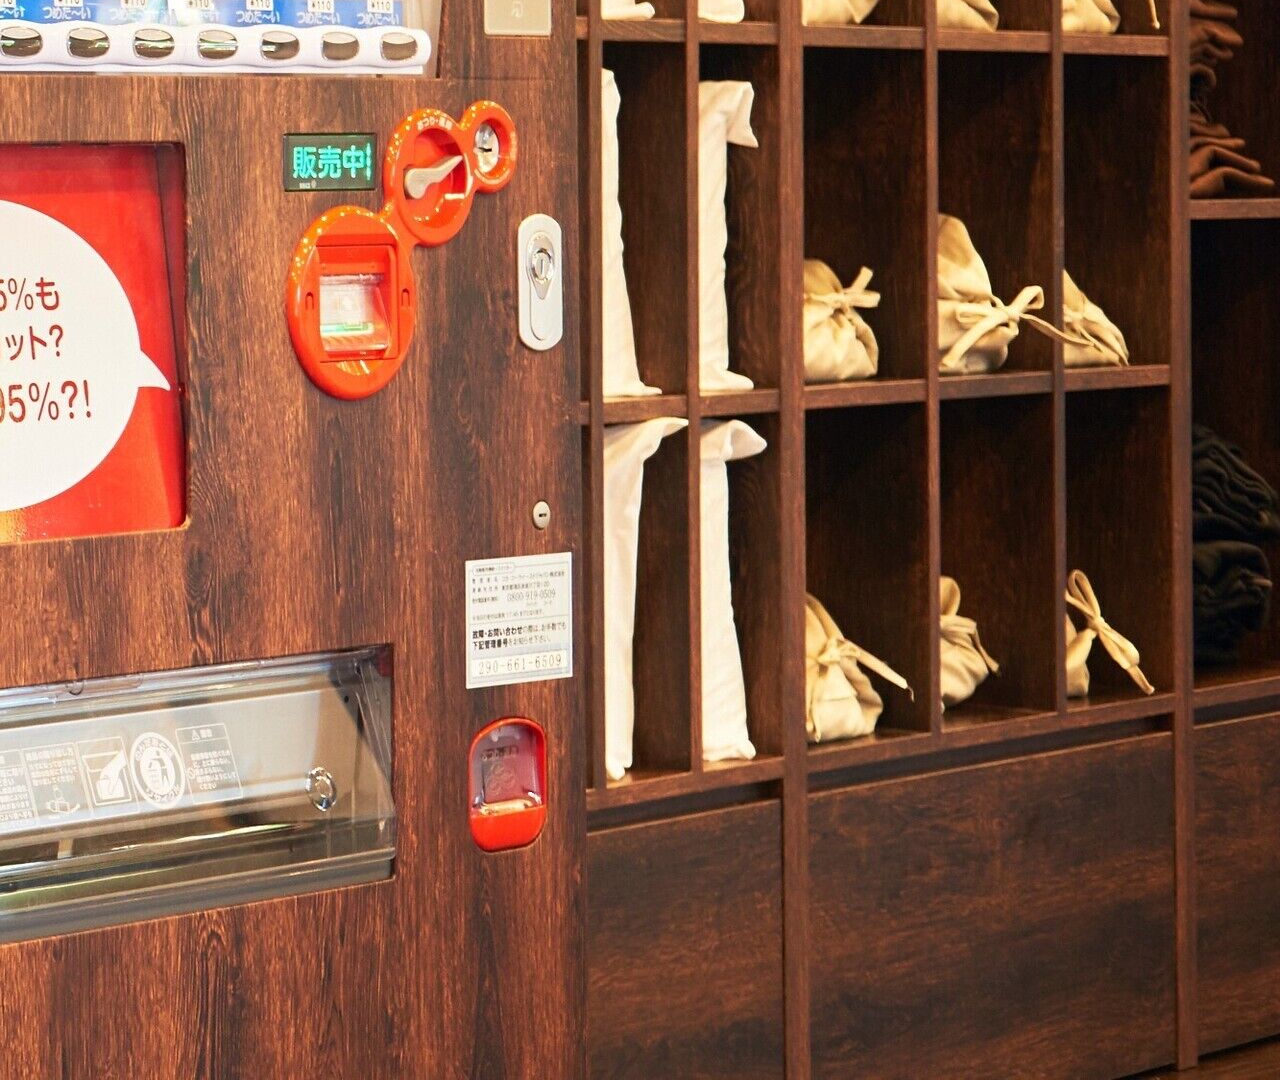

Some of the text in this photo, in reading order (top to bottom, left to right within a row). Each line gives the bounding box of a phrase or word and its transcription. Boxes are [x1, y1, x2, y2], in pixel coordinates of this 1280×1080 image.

[311, 0, 332, 11] ¥110
[292, 142, 372, 181] 販売中!
